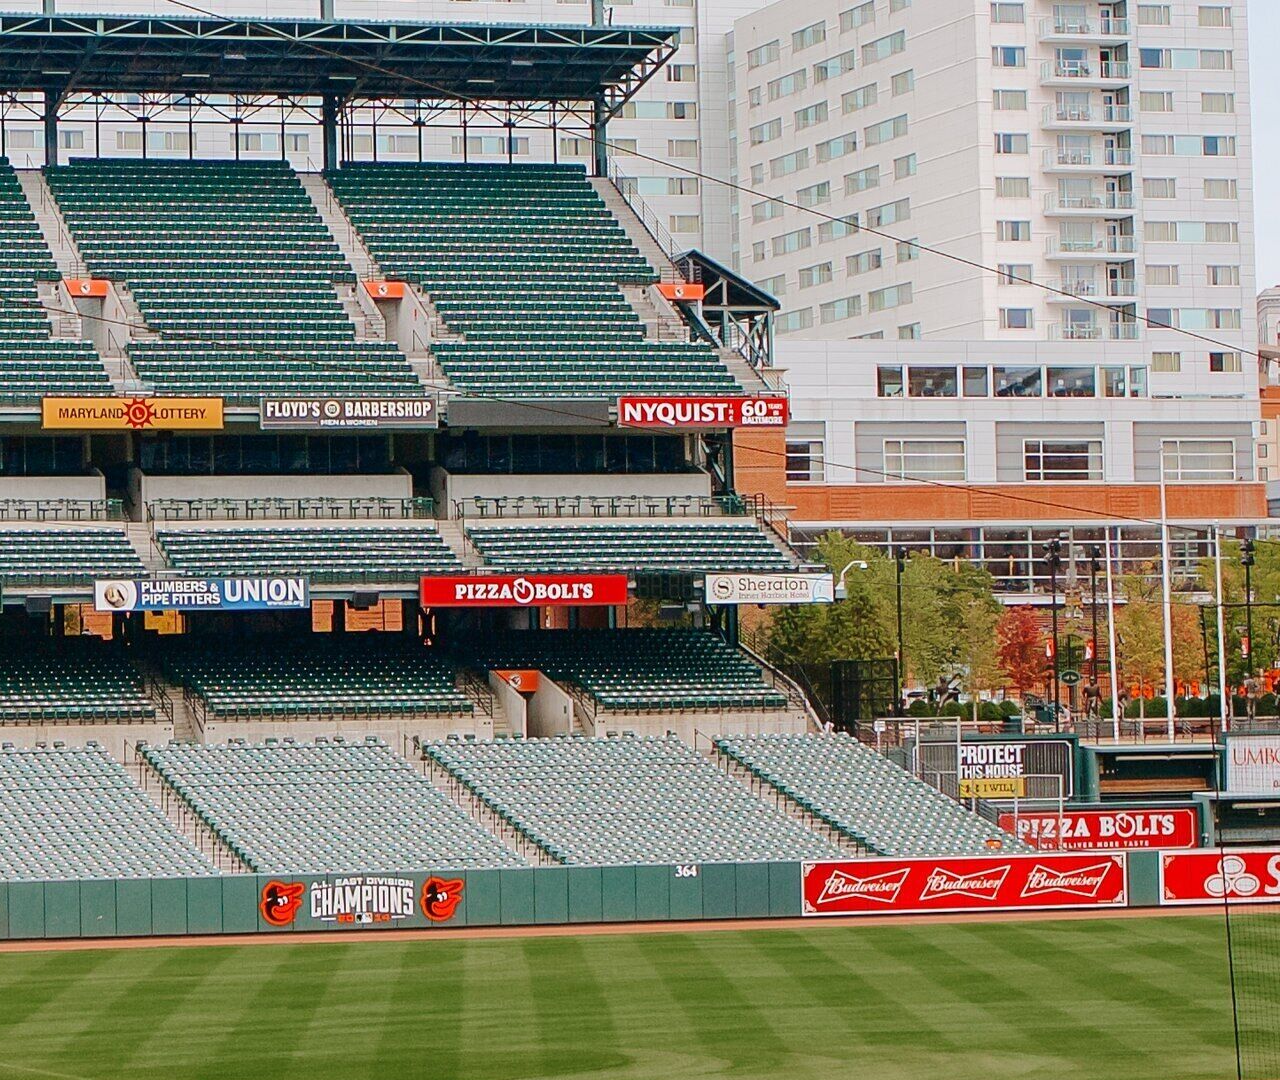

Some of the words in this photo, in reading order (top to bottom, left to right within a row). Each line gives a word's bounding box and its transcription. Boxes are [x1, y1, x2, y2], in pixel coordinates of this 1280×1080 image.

[58, 407, 124, 419] MARYLAND
[154, 407, 206, 419] LOTTERY
[266, 401, 321, 417] FLOYD'S
[344, 401, 432, 417] BARBERSHOP
[624, 402, 728, 425] NYQUIST
[741, 400, 767, 417] 60
[742, 416, 784, 425] BALTIMORE
[141, 580, 207, 593] PLUMBERS
[209, 582, 219, 592] &
[224, 579, 304, 602] UNION
[455, 583, 514, 600] PIZZA
[535, 583, 594, 600] BOLI'S
[738, 577, 809, 591] Sheraton
[141, 593, 170, 605] PIPE
[172, 593, 221, 605] FITTERS
[761, 591, 788, 599] Harbor
[960, 744, 1025, 765] PROTECT
[960, 764, 983, 778] THIS
[985, 763, 1024, 778] HOUSE
[989, 783, 1016, 792] WILL
[1017, 817, 1091, 839] PIZZA
[1099, 813, 1175, 838] BOLI'S
[1059, 841, 1093, 849] ELIVER
[675, 865, 697, 878] 364
[310, 880, 332, 890] A.L.
[335, 878, 363, 887] EAST
[366, 876, 414, 888] DIVISION
[826, 875, 900, 894] Budweiser
[927, 873, 1002, 893] Budweiser
[1028, 871, 1102, 890] Budweiser
[310, 885, 414, 918] CHAMPIONS
